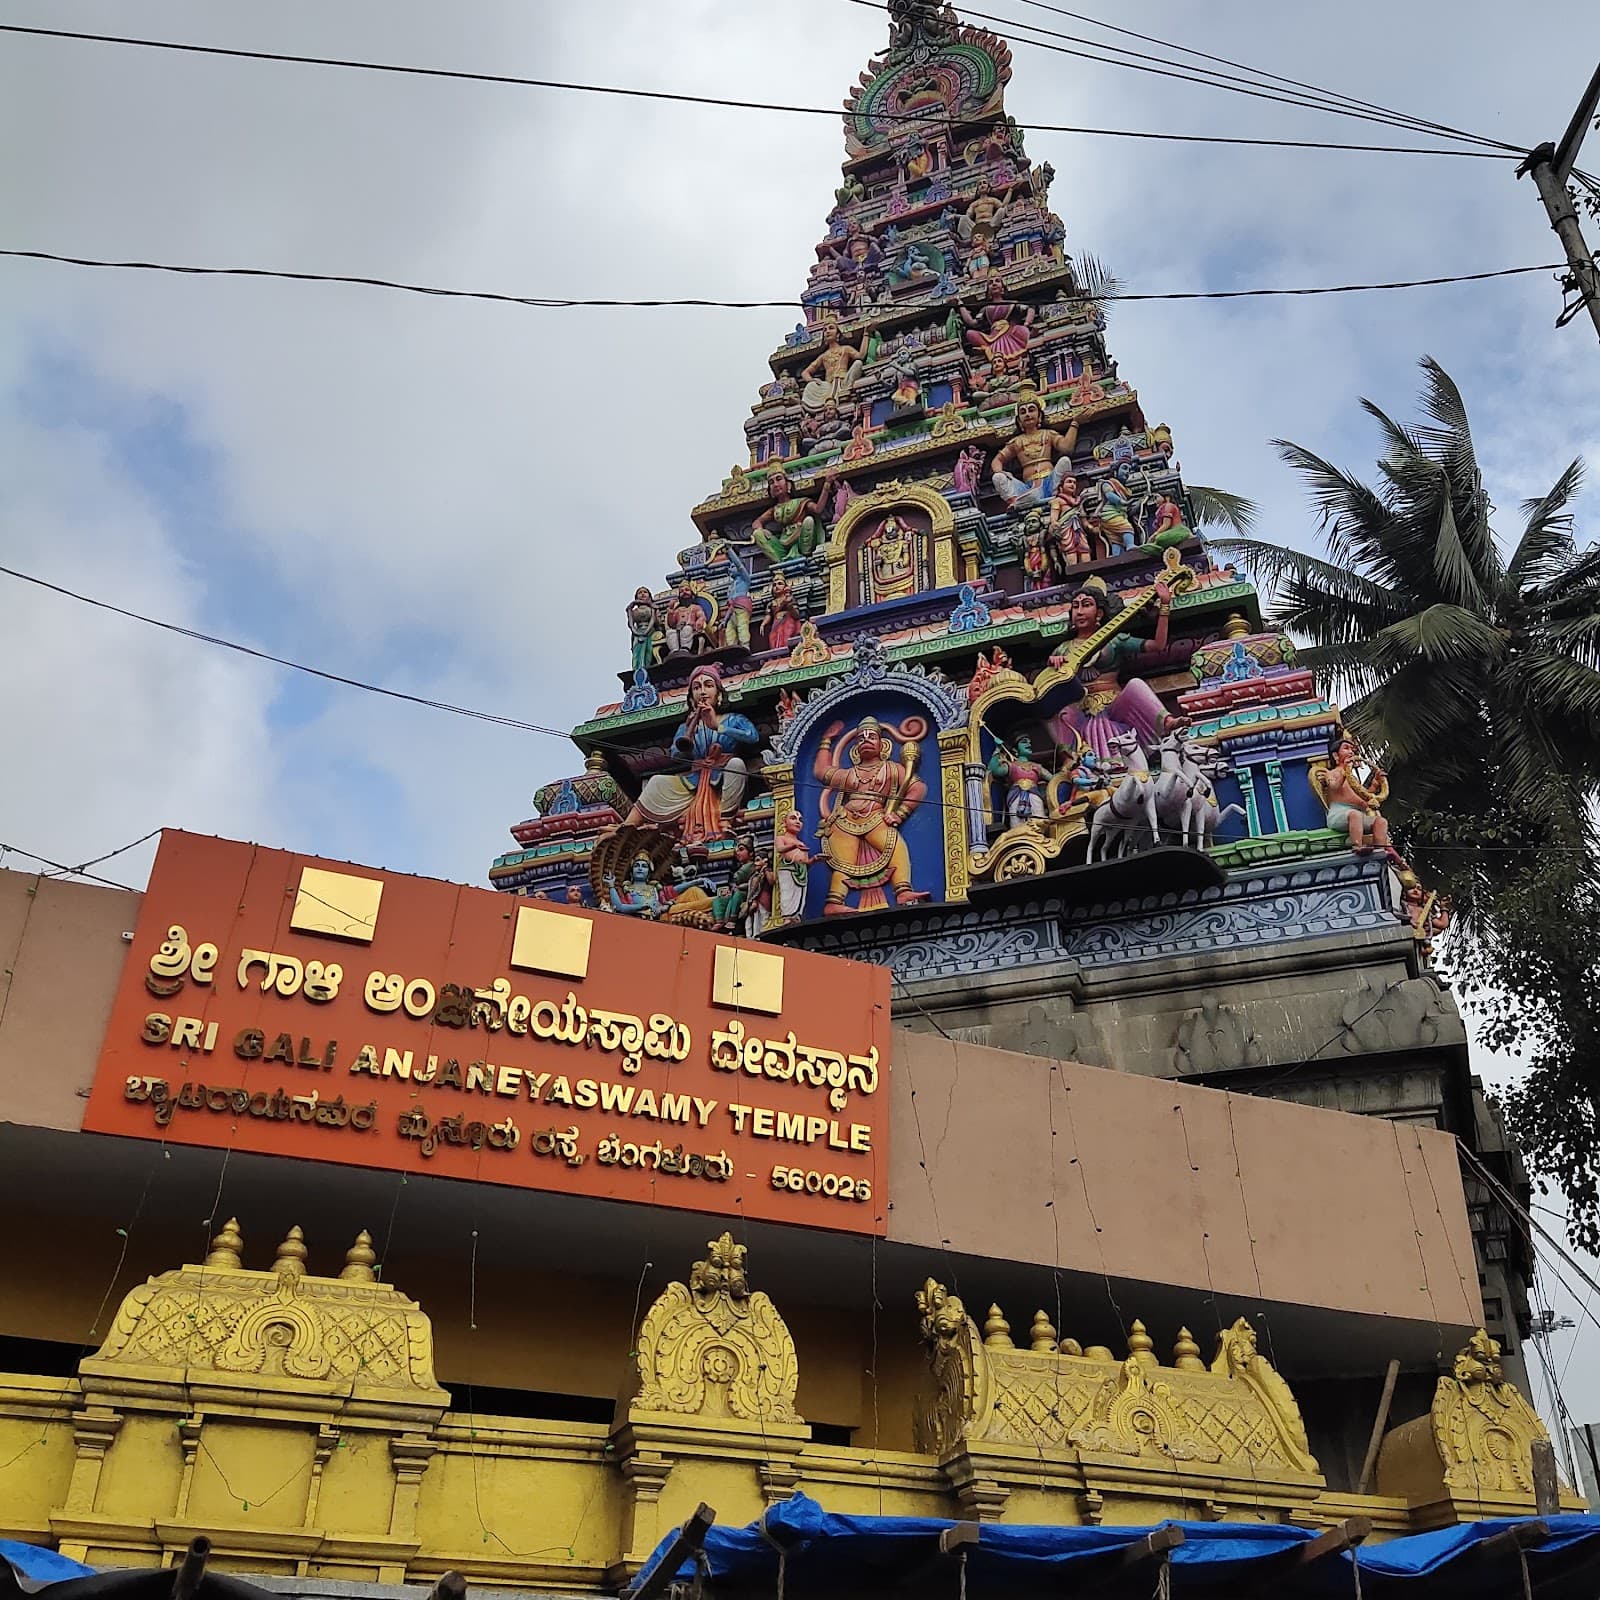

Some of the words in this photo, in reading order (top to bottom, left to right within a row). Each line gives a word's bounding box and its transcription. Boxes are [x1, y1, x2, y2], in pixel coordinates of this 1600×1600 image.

[142, 1012, 219, 1051] SRI
[234, 1027, 337, 1068] GALI
[349, 1044, 718, 1125] ANJANEYASWAMY
[729, 1103, 871, 1151] TEMPLE
[146, 925, 218, 995] ಶ್ರೀ
[237, 948, 344, 1001] ಗಾಳಿ
[711, 1020, 879, 1112] ದೇವಸ್ಥಾನ
[771, 1165, 872, 1201] 560026
